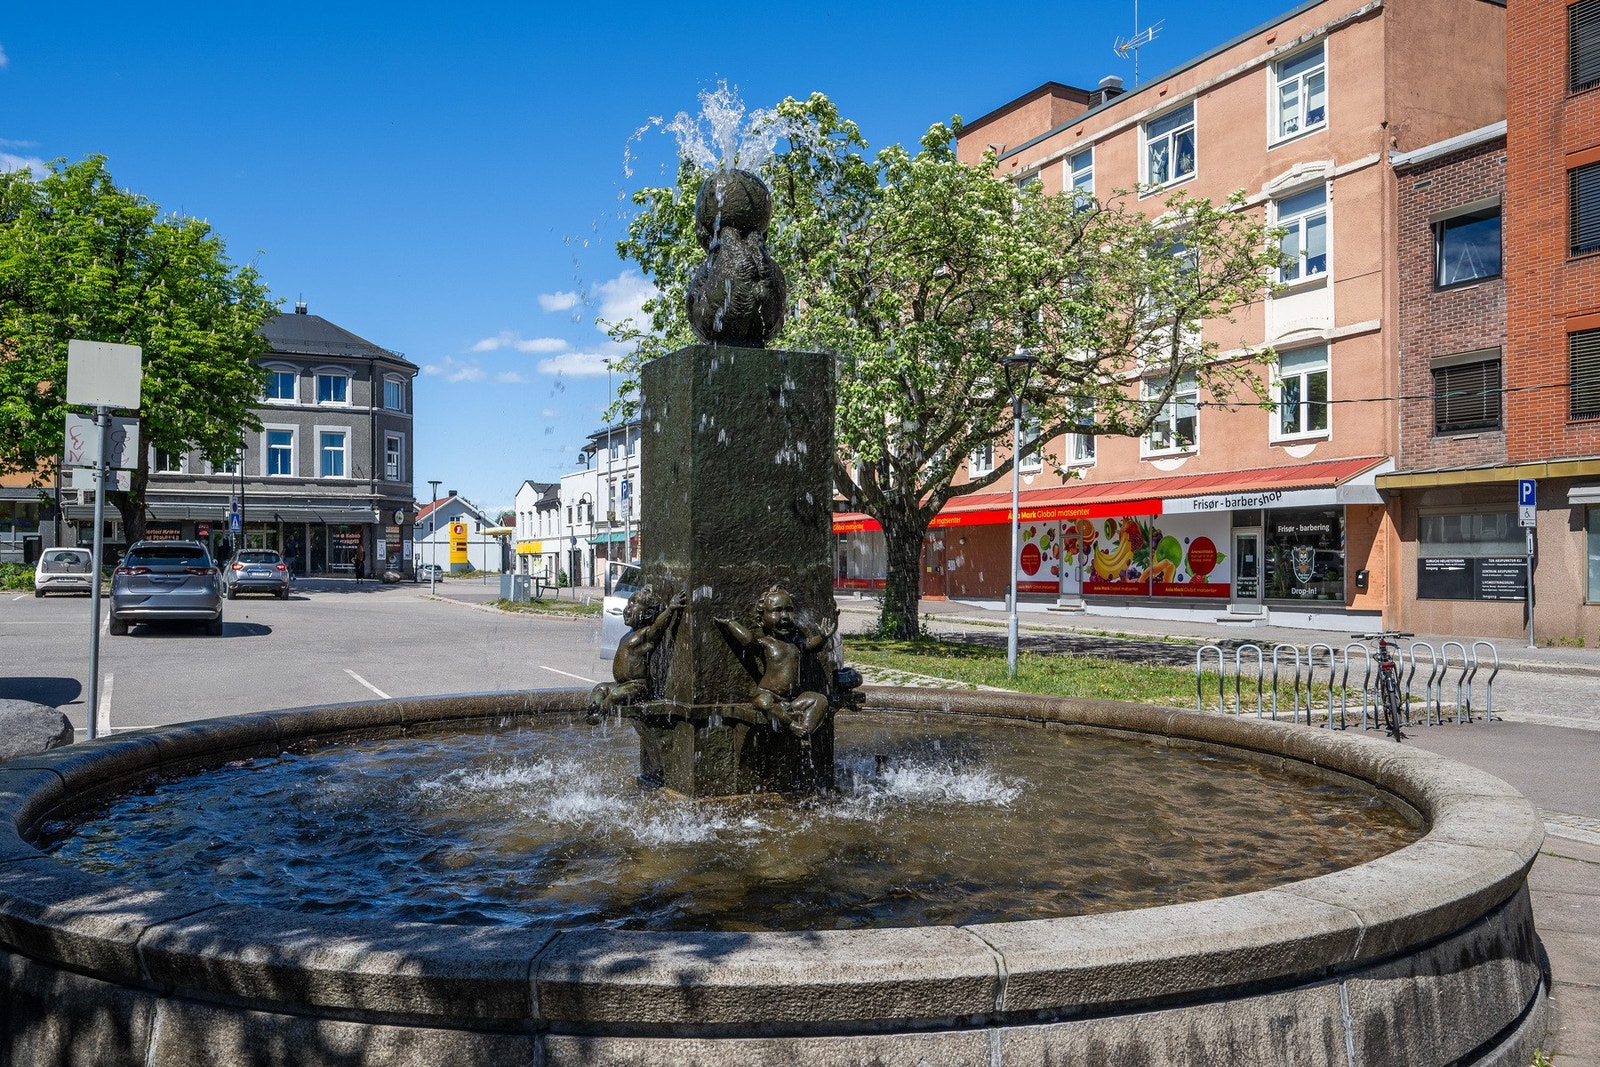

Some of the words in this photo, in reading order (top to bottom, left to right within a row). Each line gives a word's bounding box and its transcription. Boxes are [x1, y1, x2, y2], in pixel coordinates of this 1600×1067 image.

[1193, 499, 1219, 510] Frisør
[1225, 490, 1282, 508] barbershop
[1522, 482, 1532, 503] P
[1037, 509, 1057, 519] Global
[1058, 508, 1090, 517] matsenter
[1299, 523, 1330, 532] barbering
